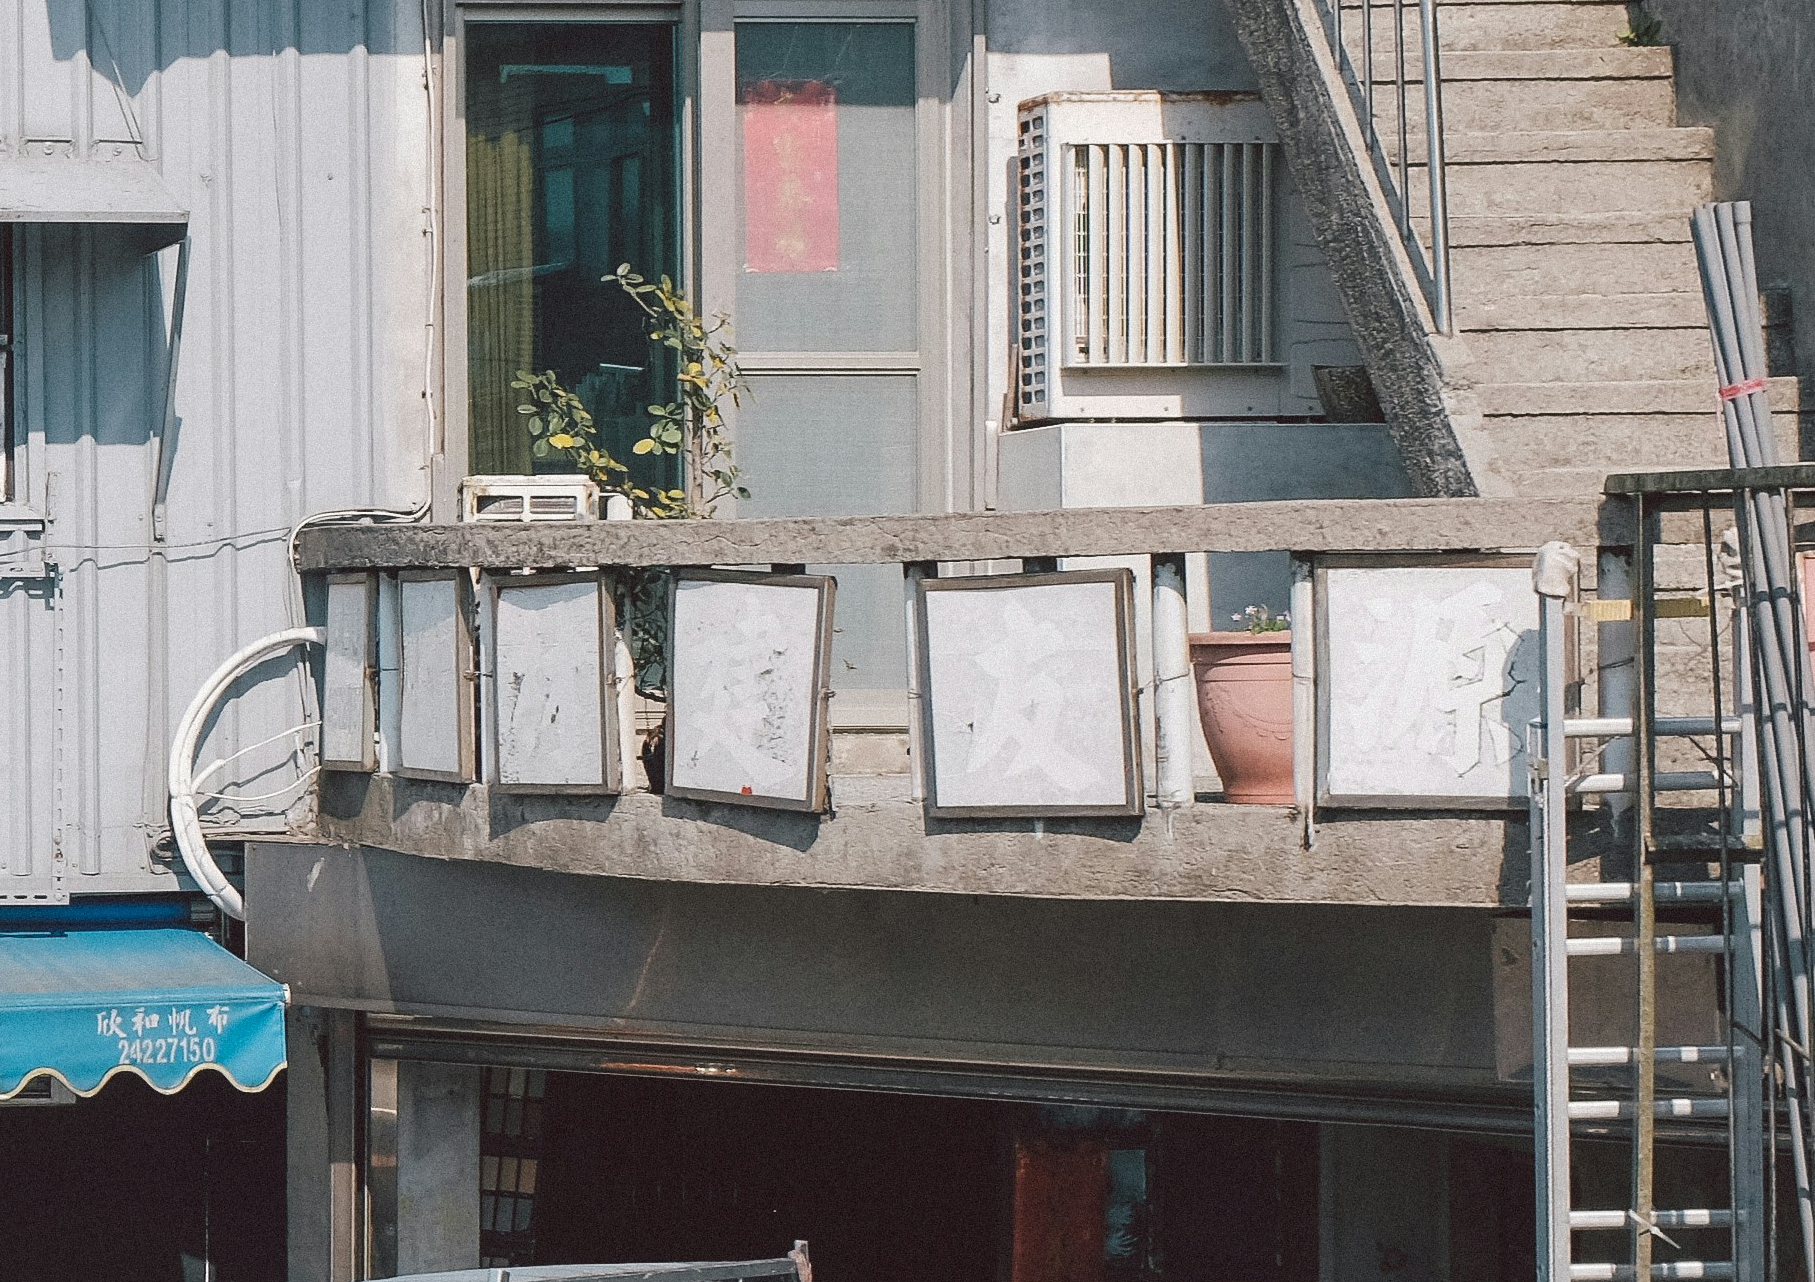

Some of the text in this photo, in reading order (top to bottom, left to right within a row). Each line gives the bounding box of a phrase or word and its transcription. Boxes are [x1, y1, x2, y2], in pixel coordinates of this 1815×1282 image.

[96, 1004, 230, 1038] 欣和帆布
[118, 1036, 215, 1065] 24227150
